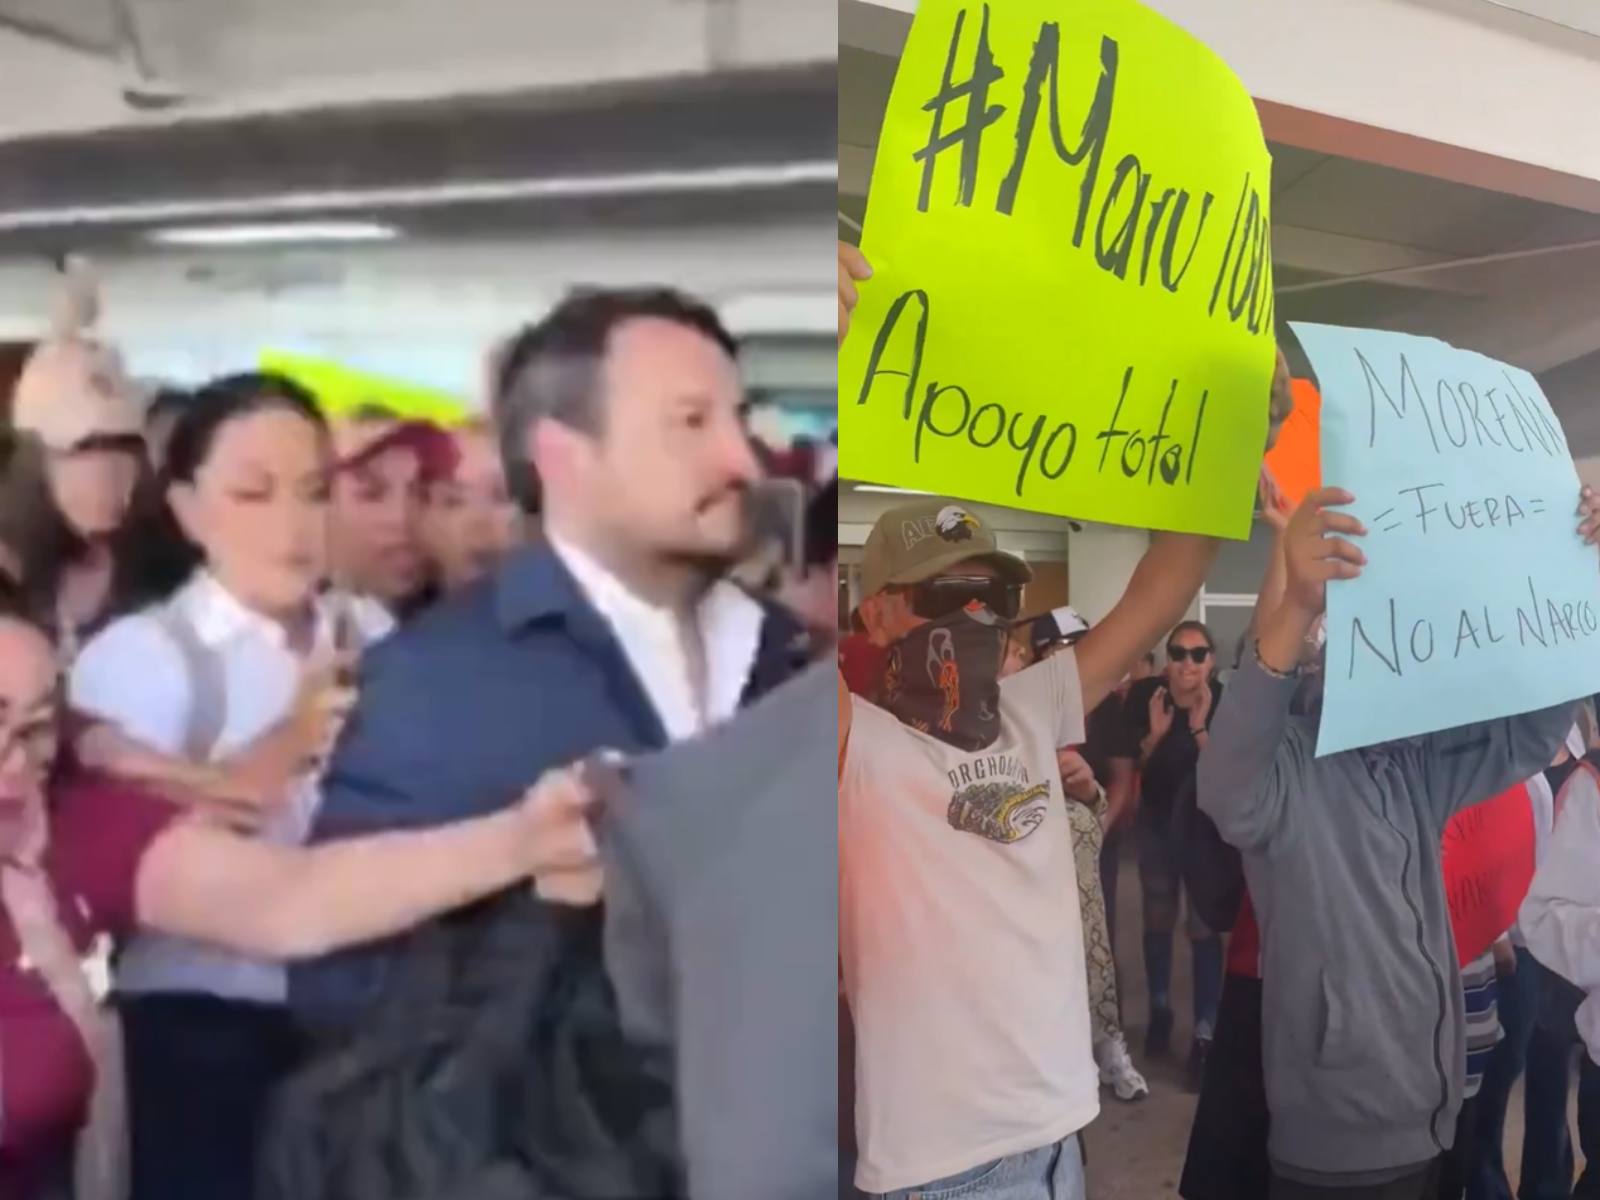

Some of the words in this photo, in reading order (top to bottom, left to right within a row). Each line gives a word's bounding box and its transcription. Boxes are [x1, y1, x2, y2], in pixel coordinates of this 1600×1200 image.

[912, 2, 1214, 293] #Maru
[857, 288, 1077, 496] Apoyo
[1348, 597, 1434, 680] NO
[1453, 603, 1504, 659] AL
